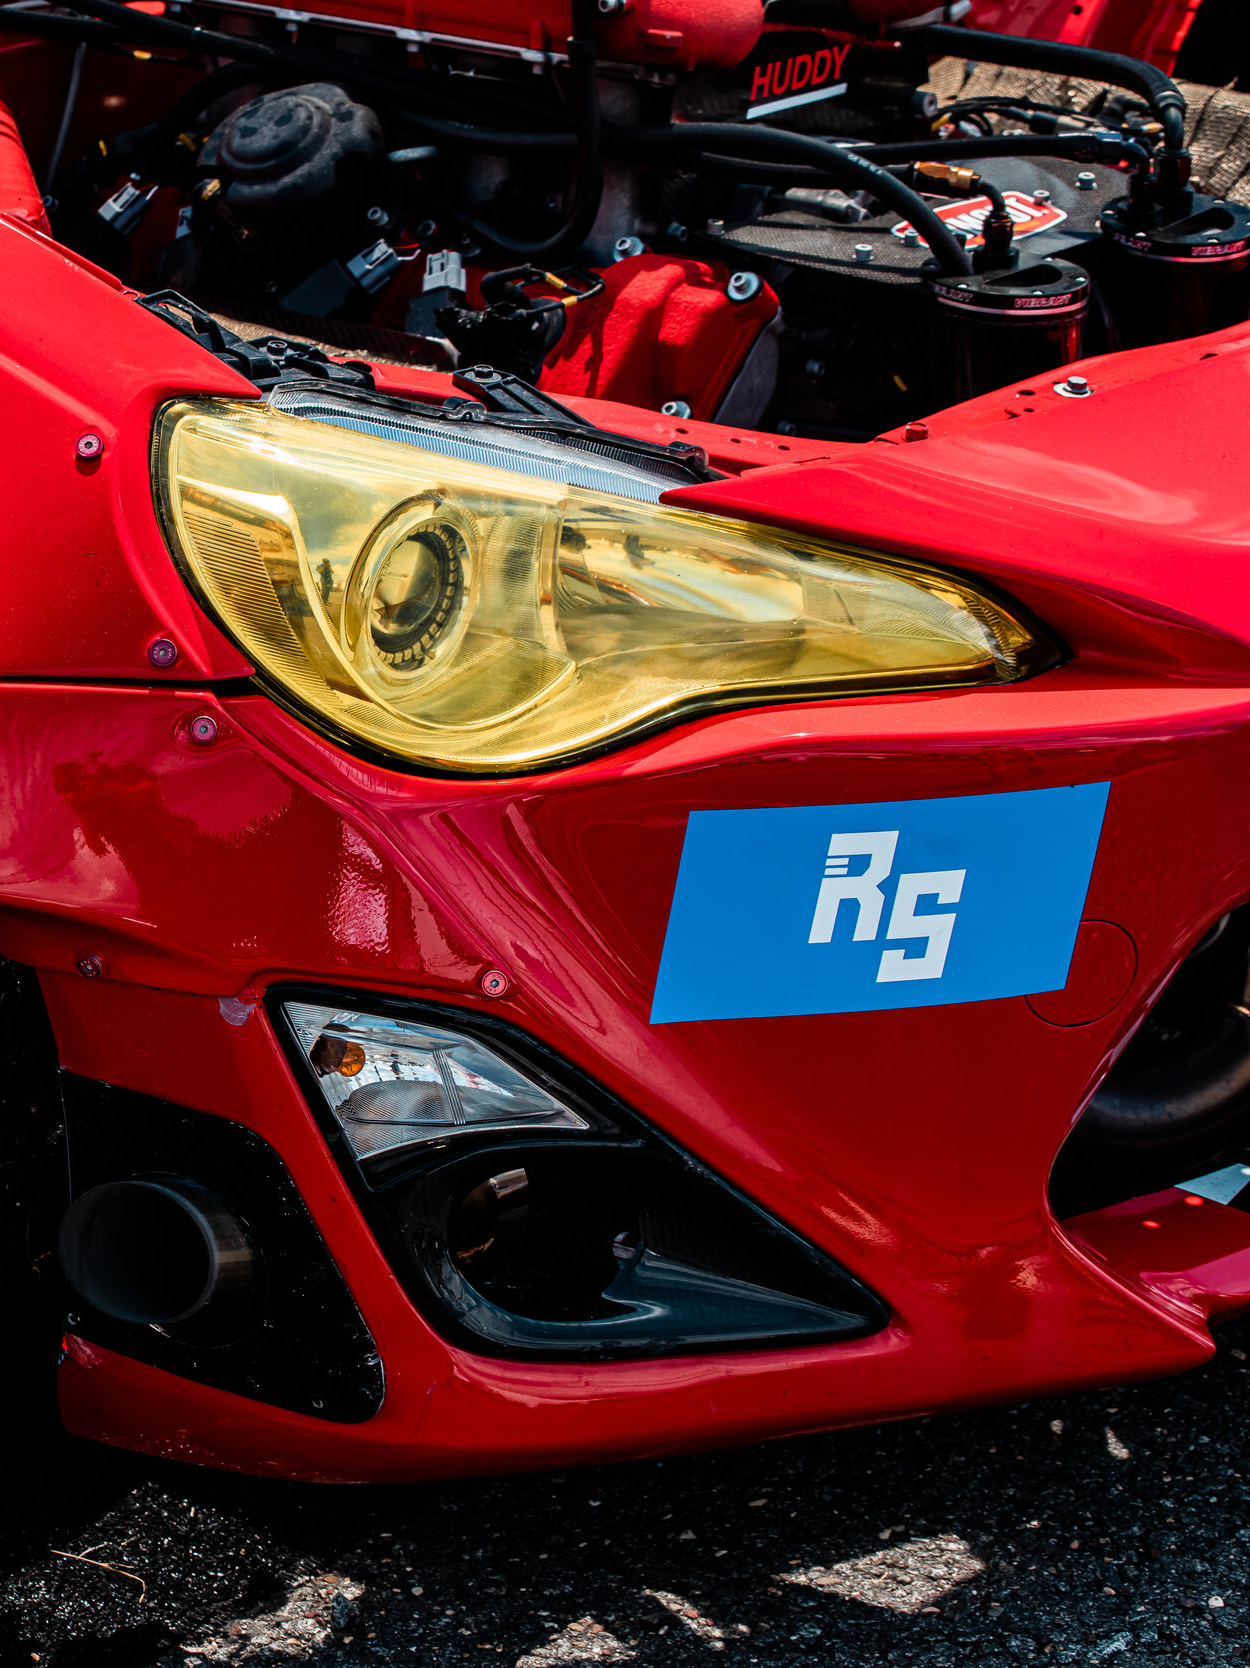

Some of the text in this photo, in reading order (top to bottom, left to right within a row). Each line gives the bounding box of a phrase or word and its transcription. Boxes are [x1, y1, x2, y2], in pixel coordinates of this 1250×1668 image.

[750, 43, 852, 101] HUDDY
[1013, 293, 1072, 308] VIBRANT
[807, 829, 967, 983] RS
